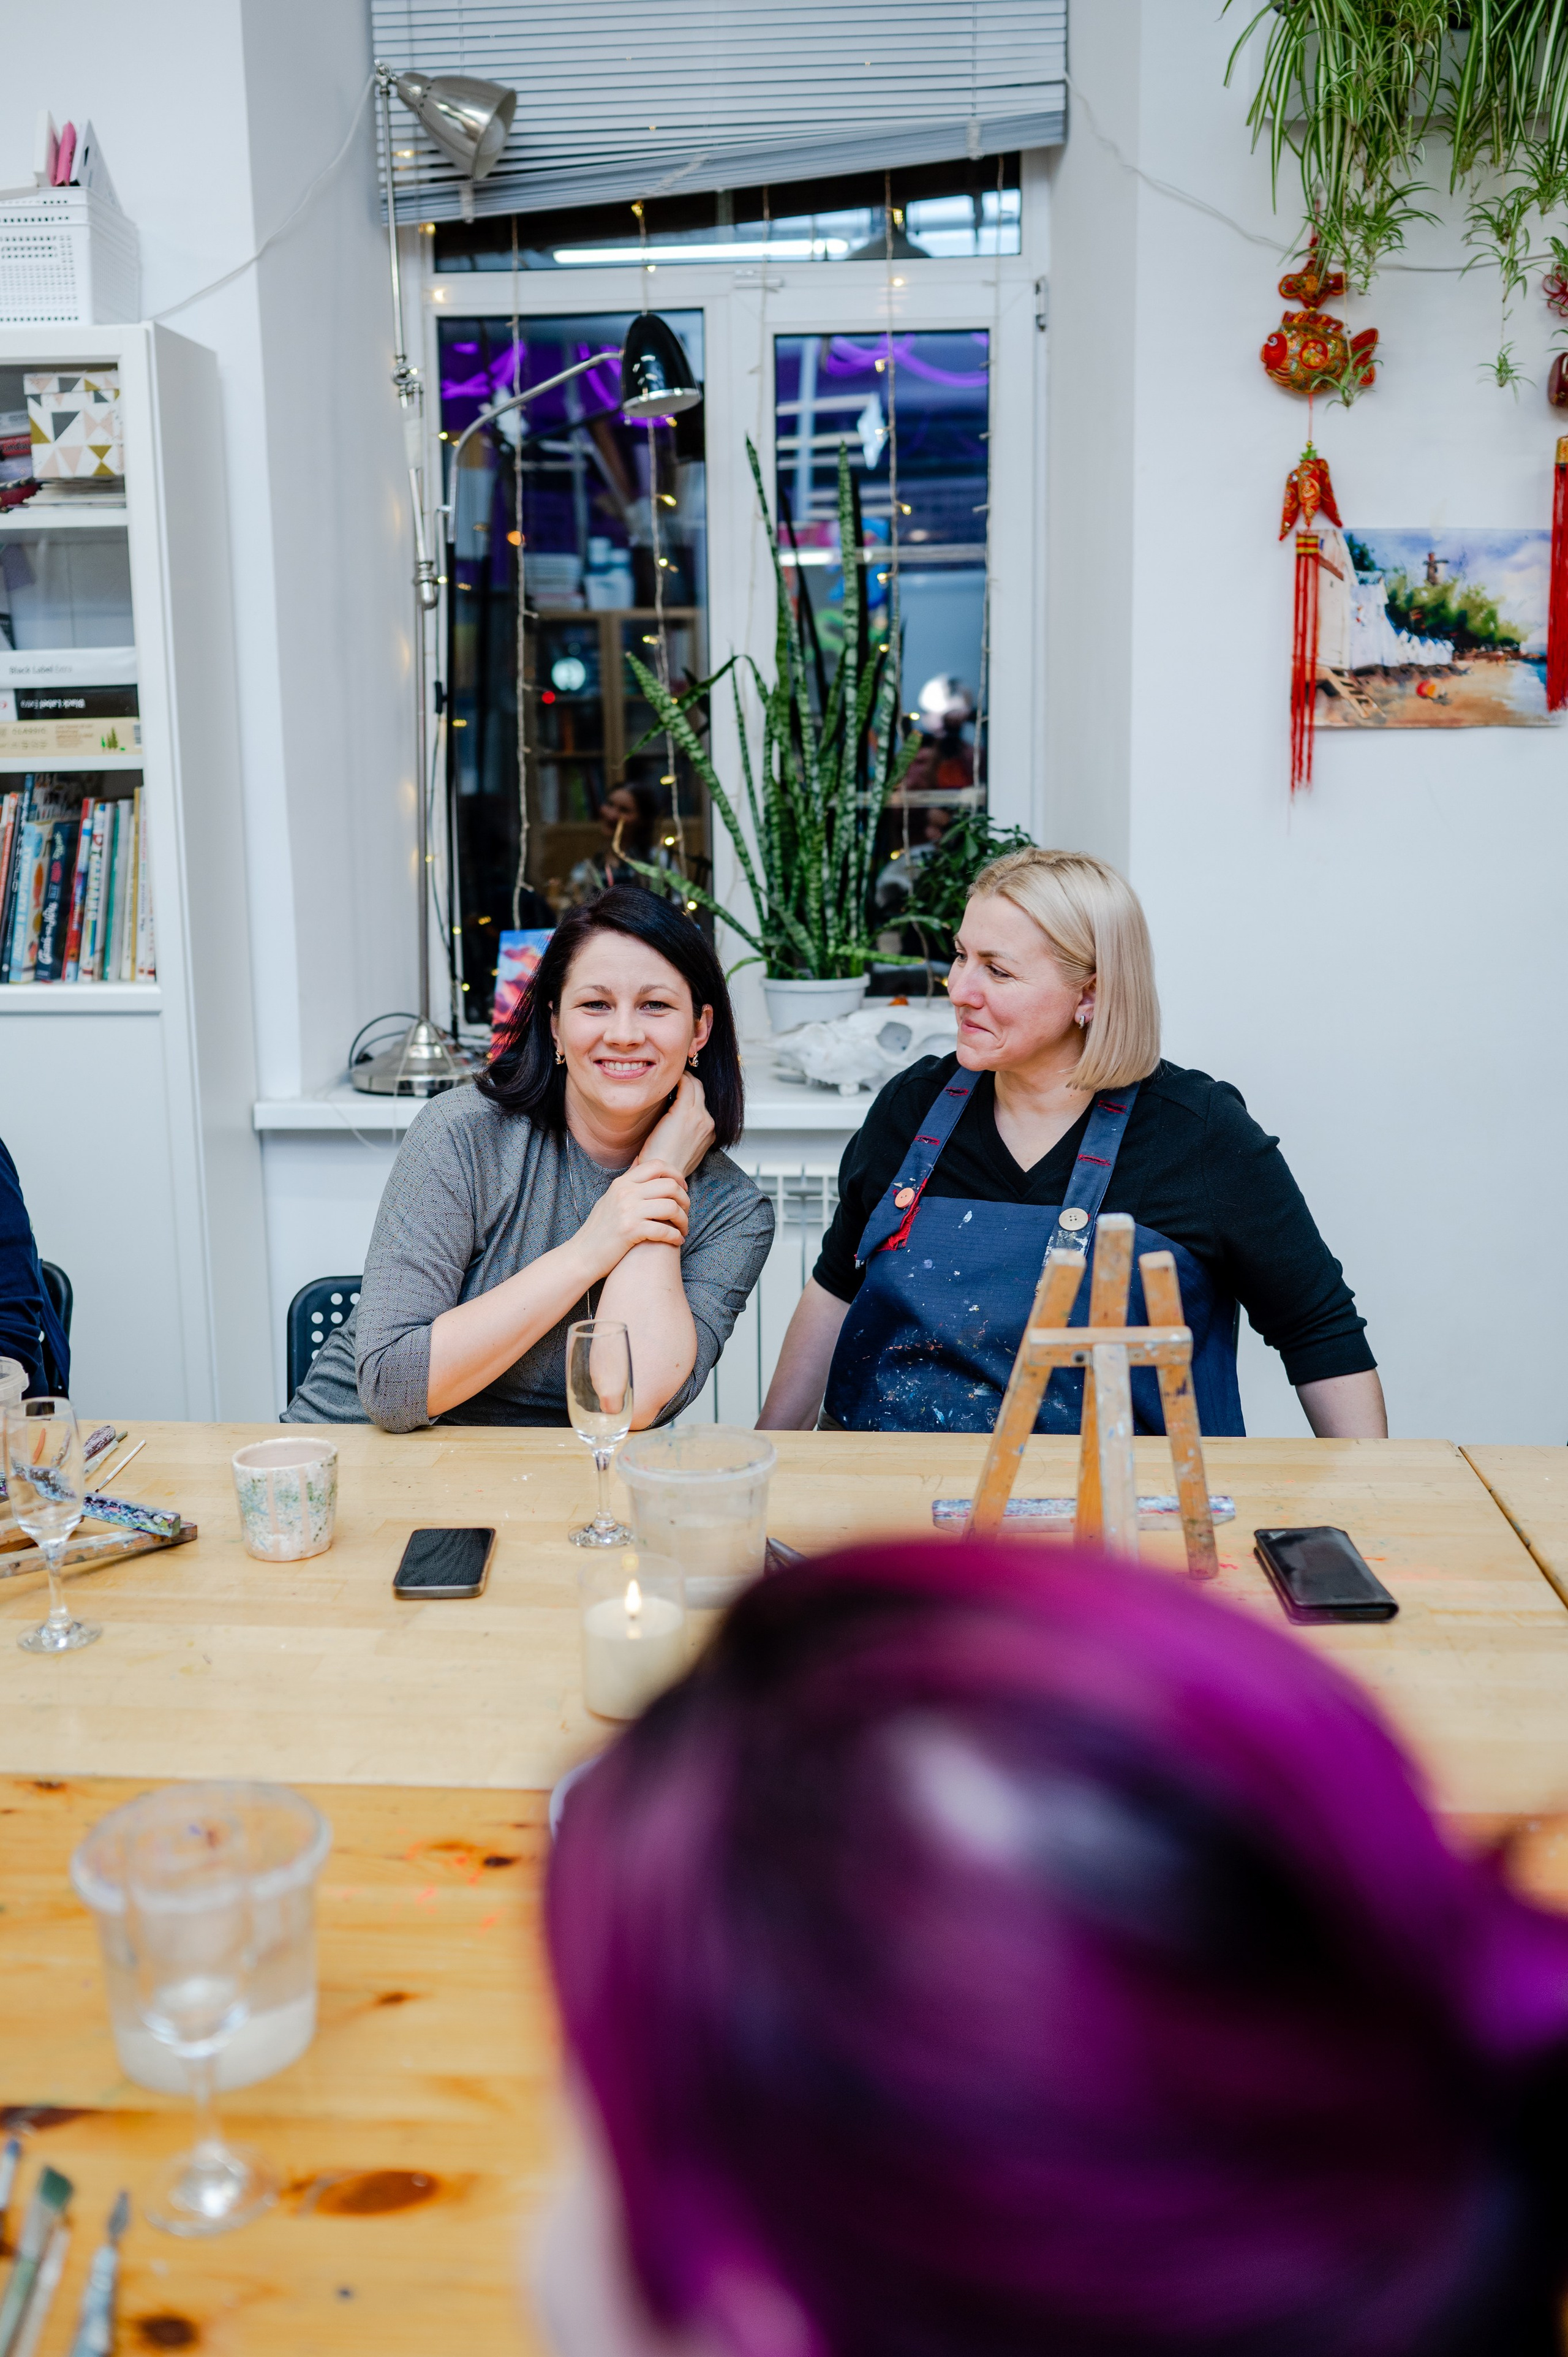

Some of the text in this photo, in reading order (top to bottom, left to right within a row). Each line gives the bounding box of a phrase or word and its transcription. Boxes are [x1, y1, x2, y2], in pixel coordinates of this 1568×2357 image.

[9, 665, 30, 674] Black
[32, 664, 53, 674] Label
[20, 698, 86, 709] Black Label Extra
